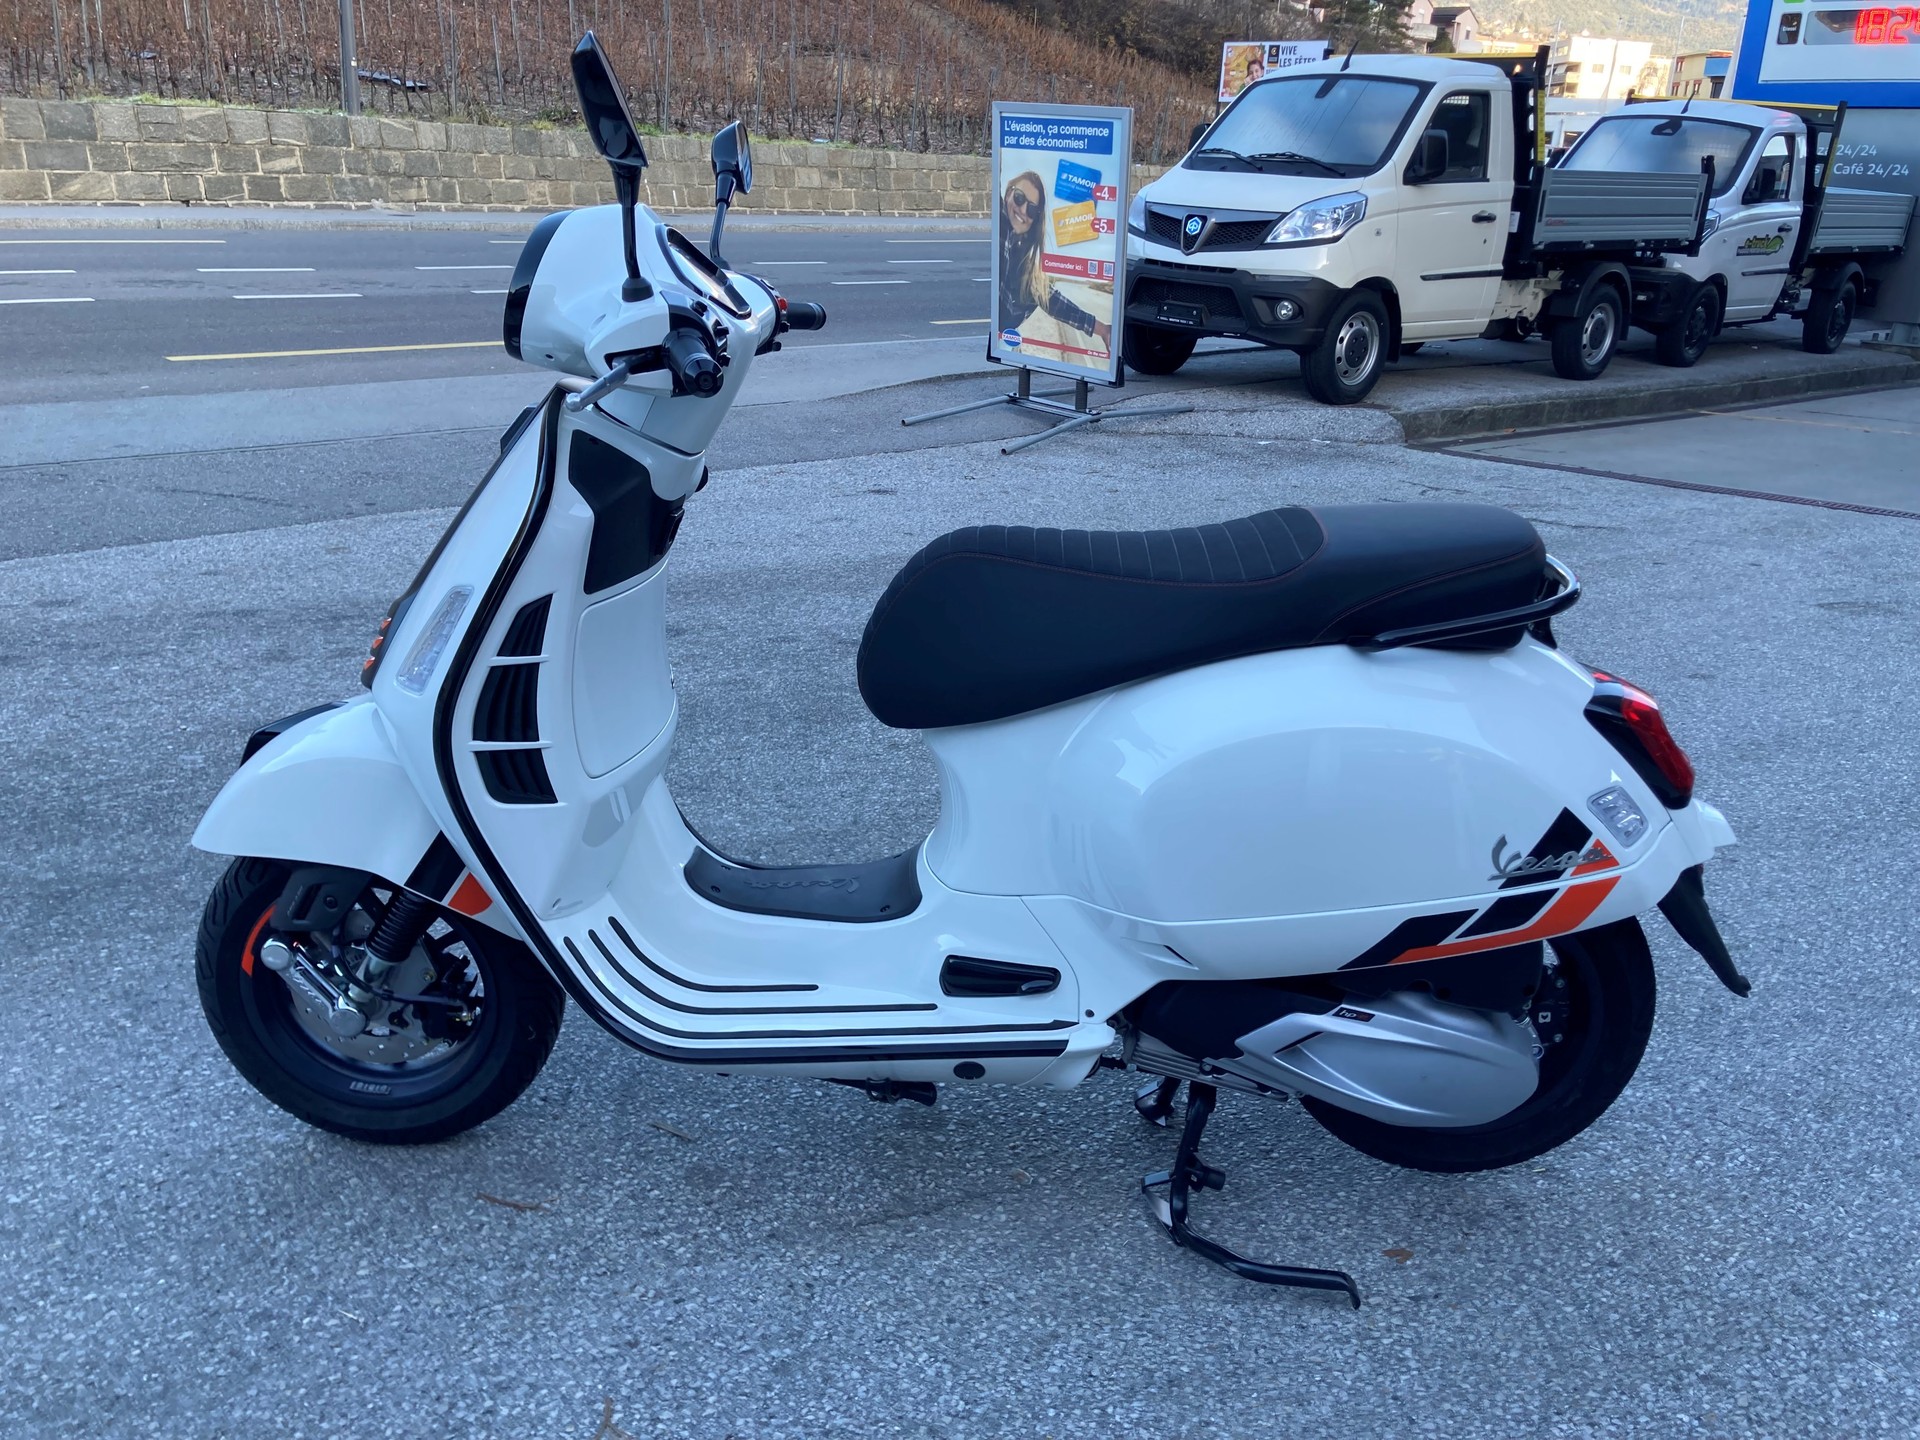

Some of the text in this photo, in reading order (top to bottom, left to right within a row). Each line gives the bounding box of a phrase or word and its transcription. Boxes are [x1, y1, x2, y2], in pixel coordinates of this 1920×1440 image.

[1281, 46, 1298, 56] VIVE
[1279, 57, 1292, 67] LES
[1004, 120, 1109, 136] L'évasion, ça commence
[1004, 135, 1018, 146] par
[1019, 134, 1035, 146] des
[1836, 144, 1877, 159] 24/24
[1833, 163, 1864, 175] Café
[1867, 164, 1909, 178] 24/24
[1065, 213, 1095, 225] TAMOIL
[1044, 259, 1075, 270] Commander
[1487, 834, 1613, 881] Vespa
